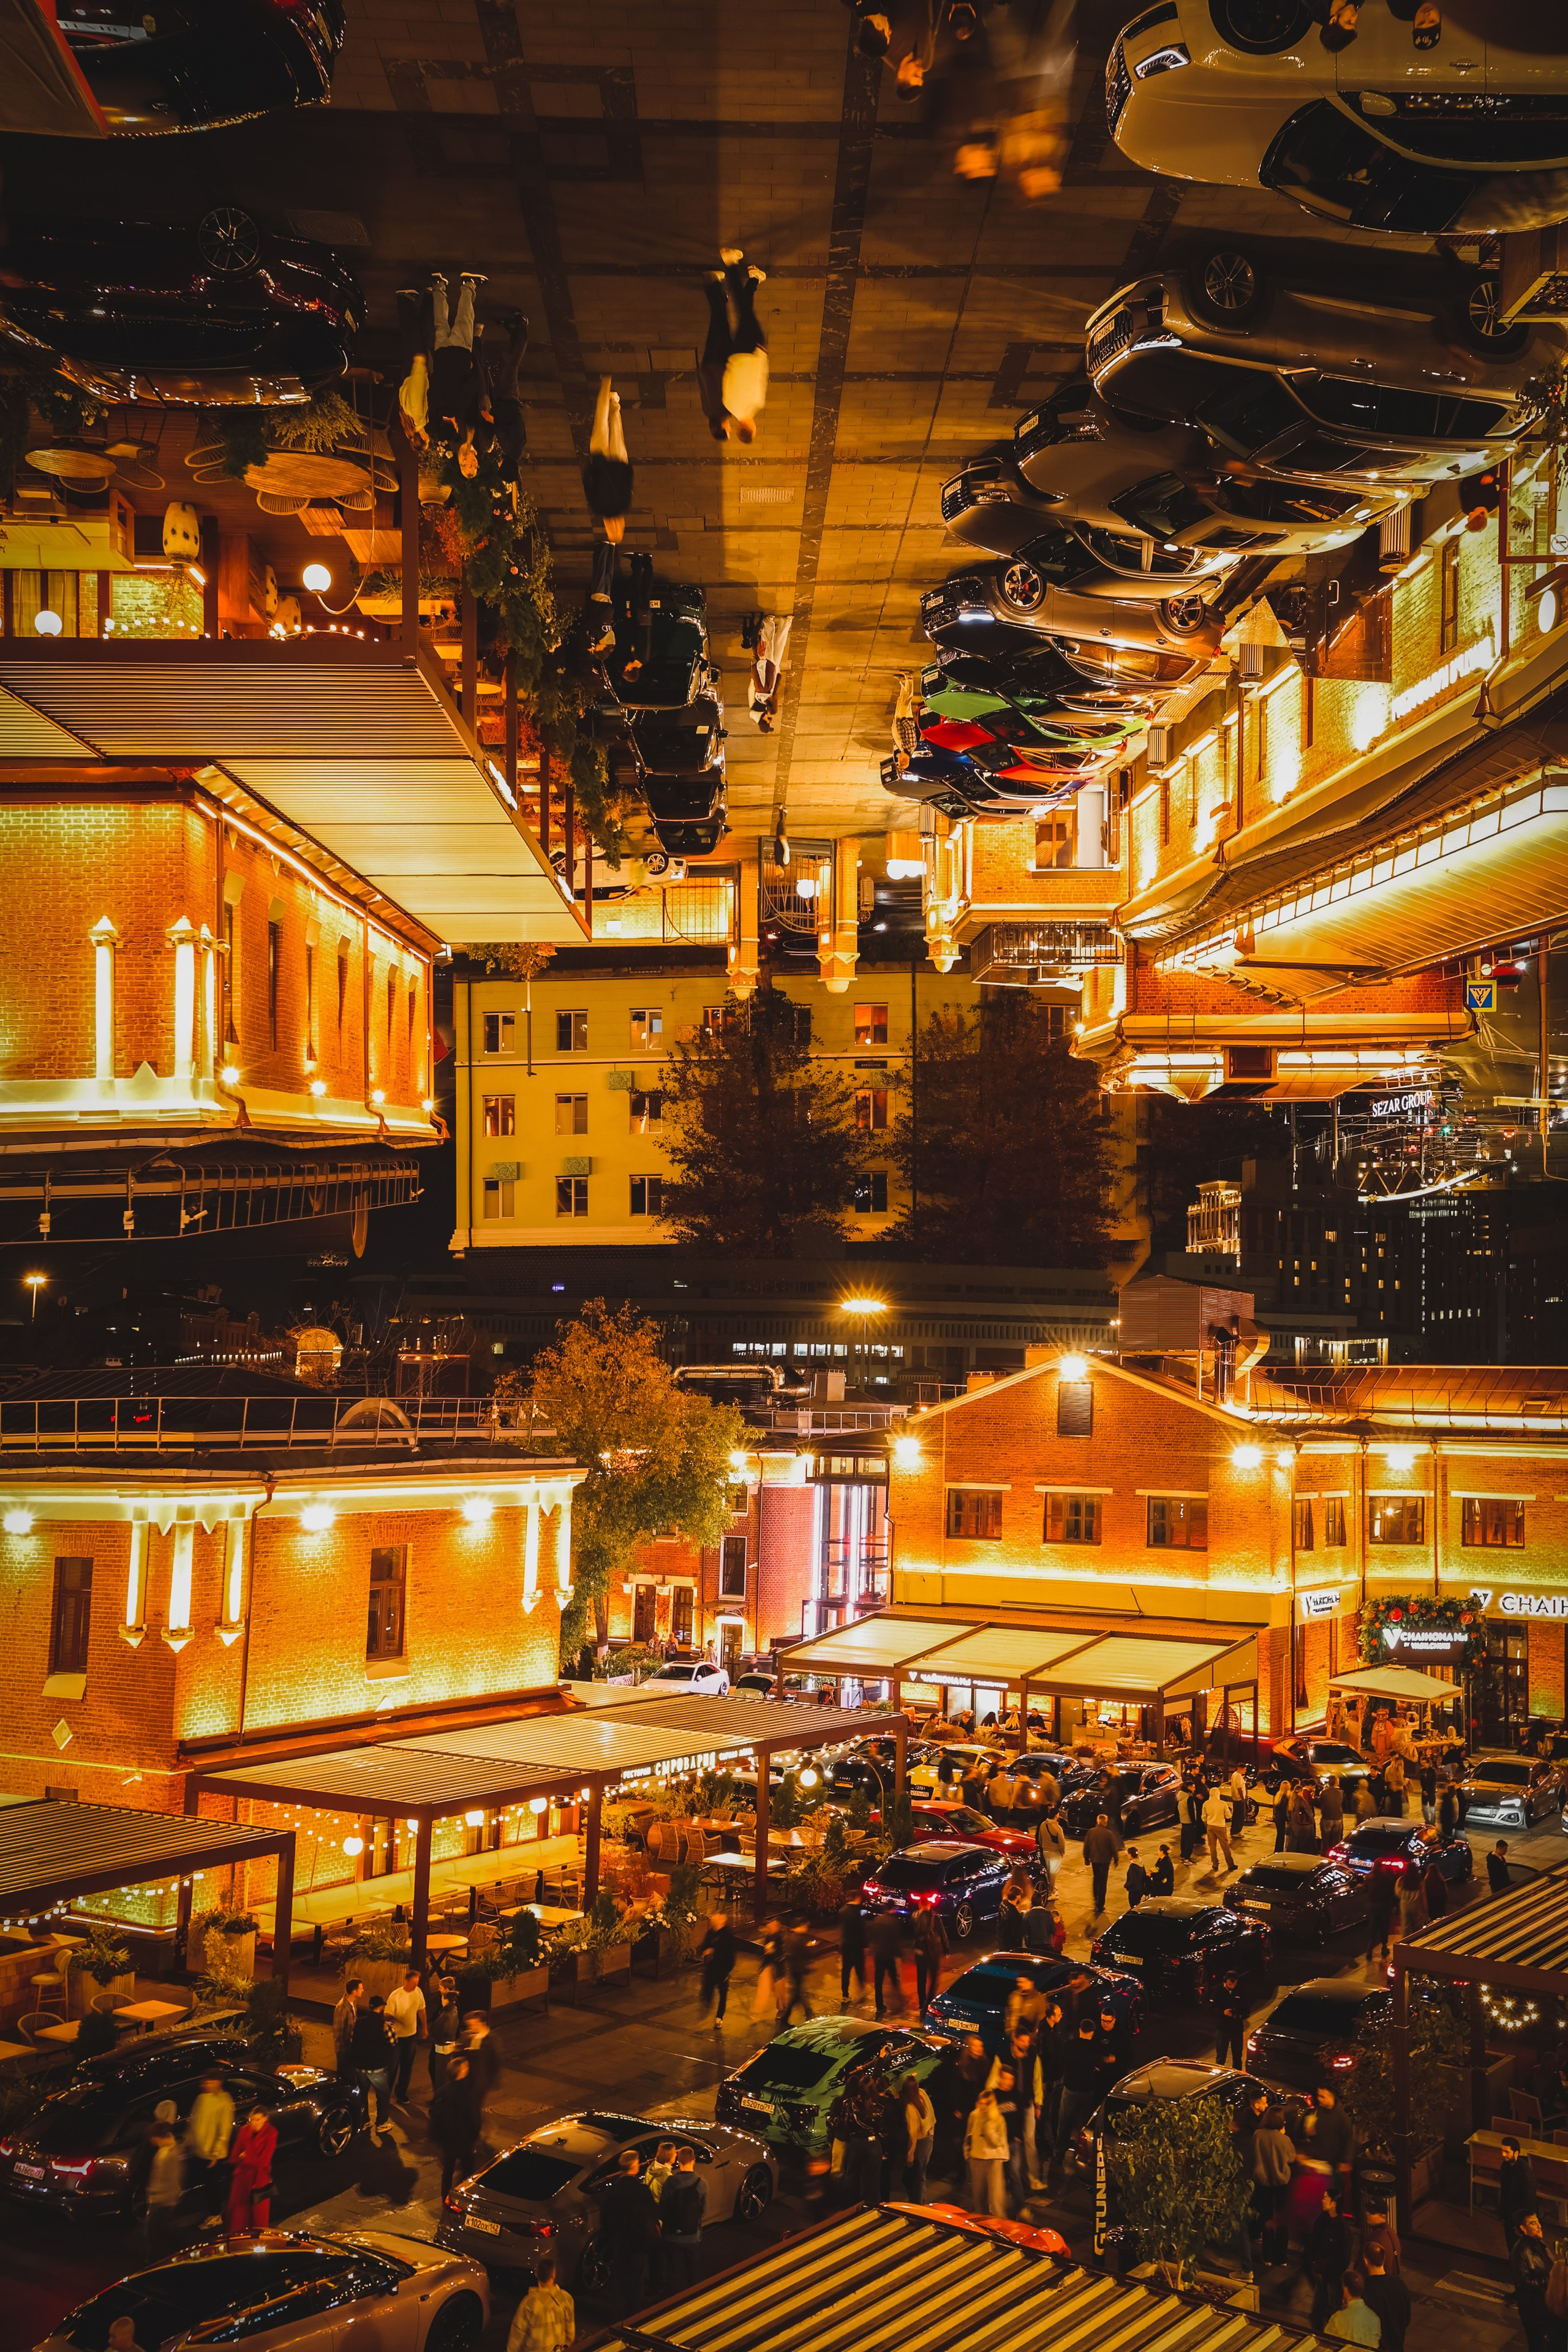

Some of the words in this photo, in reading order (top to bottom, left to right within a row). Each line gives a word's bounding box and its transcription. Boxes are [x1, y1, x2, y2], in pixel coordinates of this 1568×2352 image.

[1372, 1097, 1400, 1117] SEZAR
[1401, 1090, 1433, 1110] GROUP
[1400, 1632, 1453, 1642] CHAIHONA
[623, 1766, 651, 1779] РЕСТОРАН
[655, 1752, 716, 1776] СЫРОВАРНЯ
